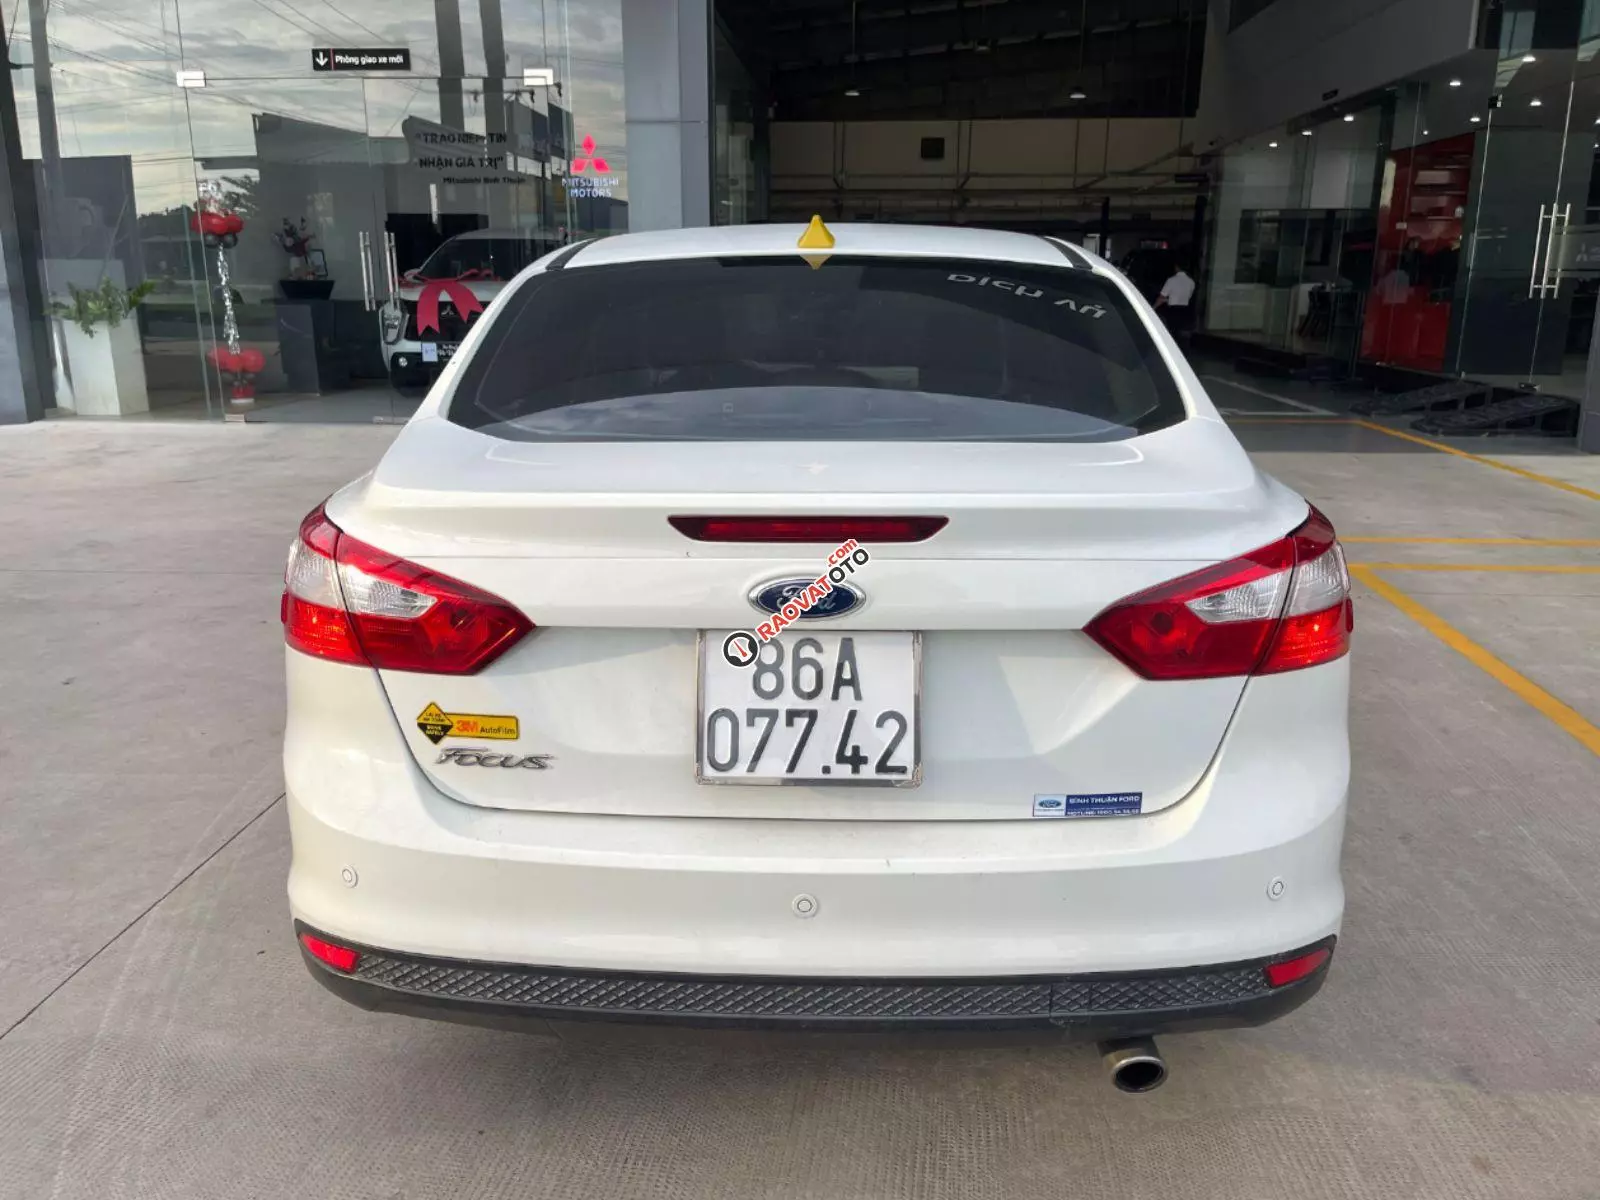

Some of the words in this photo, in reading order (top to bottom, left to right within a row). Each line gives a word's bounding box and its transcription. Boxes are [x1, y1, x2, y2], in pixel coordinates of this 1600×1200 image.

[335, 53, 359, 65] Phòng
[360, 53, 377, 65] giao
[488, 131, 507, 143] TIN
[562, 177, 619, 187] MITSUBISHI
[570, 187, 612, 198] MOTORS
[752, 636, 862, 701] 86A
[456, 719, 479, 733] 3M
[480, 726, 516, 735] AutoFilm
[706, 707, 908, 775] 077.42
